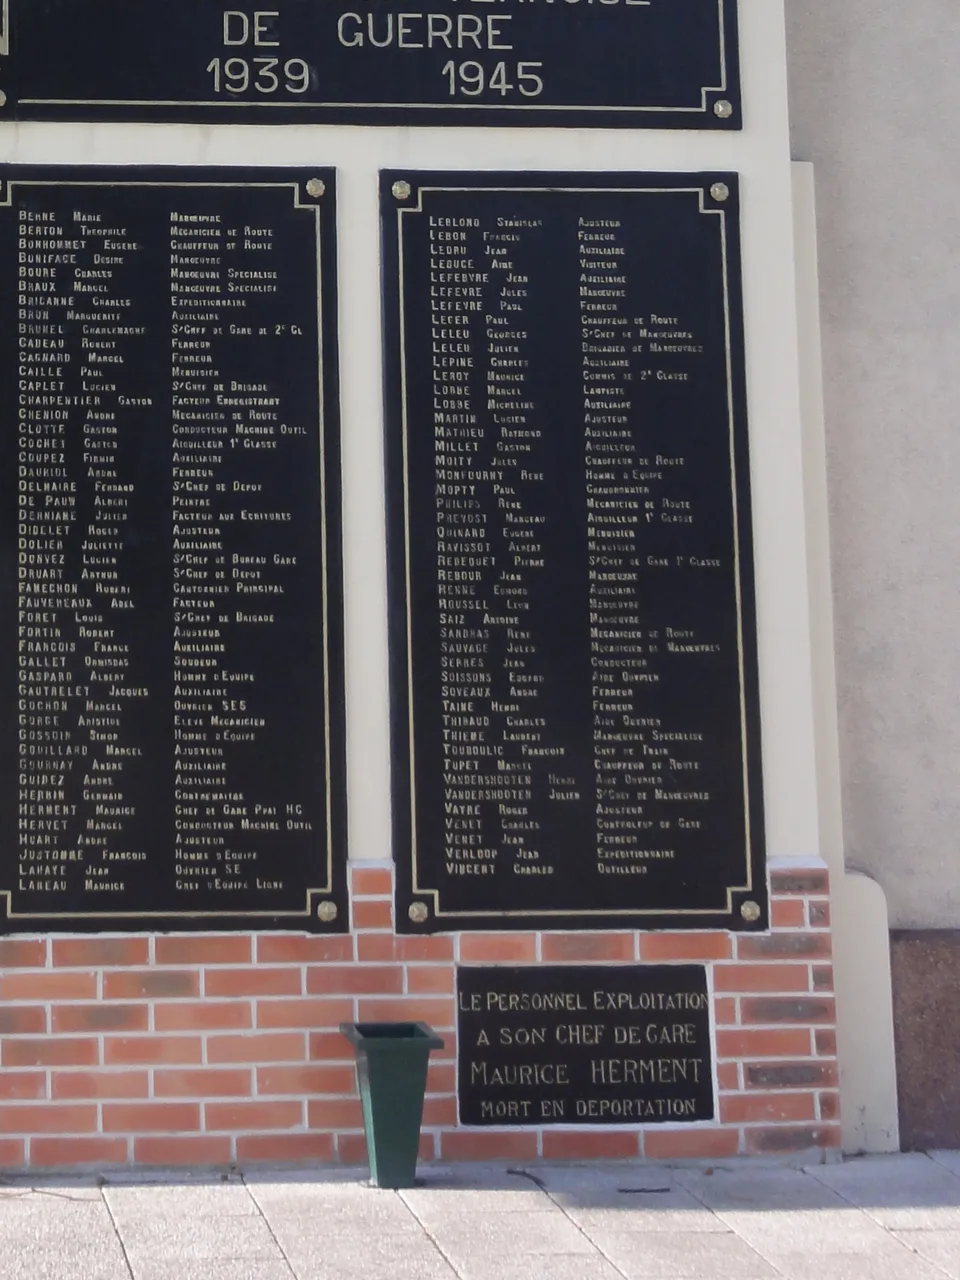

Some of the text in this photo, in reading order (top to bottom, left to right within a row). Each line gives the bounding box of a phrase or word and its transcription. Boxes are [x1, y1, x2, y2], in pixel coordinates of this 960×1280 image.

[224, 11, 512, 49] DE GUERRE
[207, 58, 542, 96] 1939 1945
[460, 991, 708, 1011] LE PERSONNEL EXPLOITATION
[477, 1024, 696, 1045] A SON CHEF DE GARE
[470, 1058, 702, 1085] MAURICE HERMENT
[481, 1099, 696, 1118] MORT EN DEPORTATION
